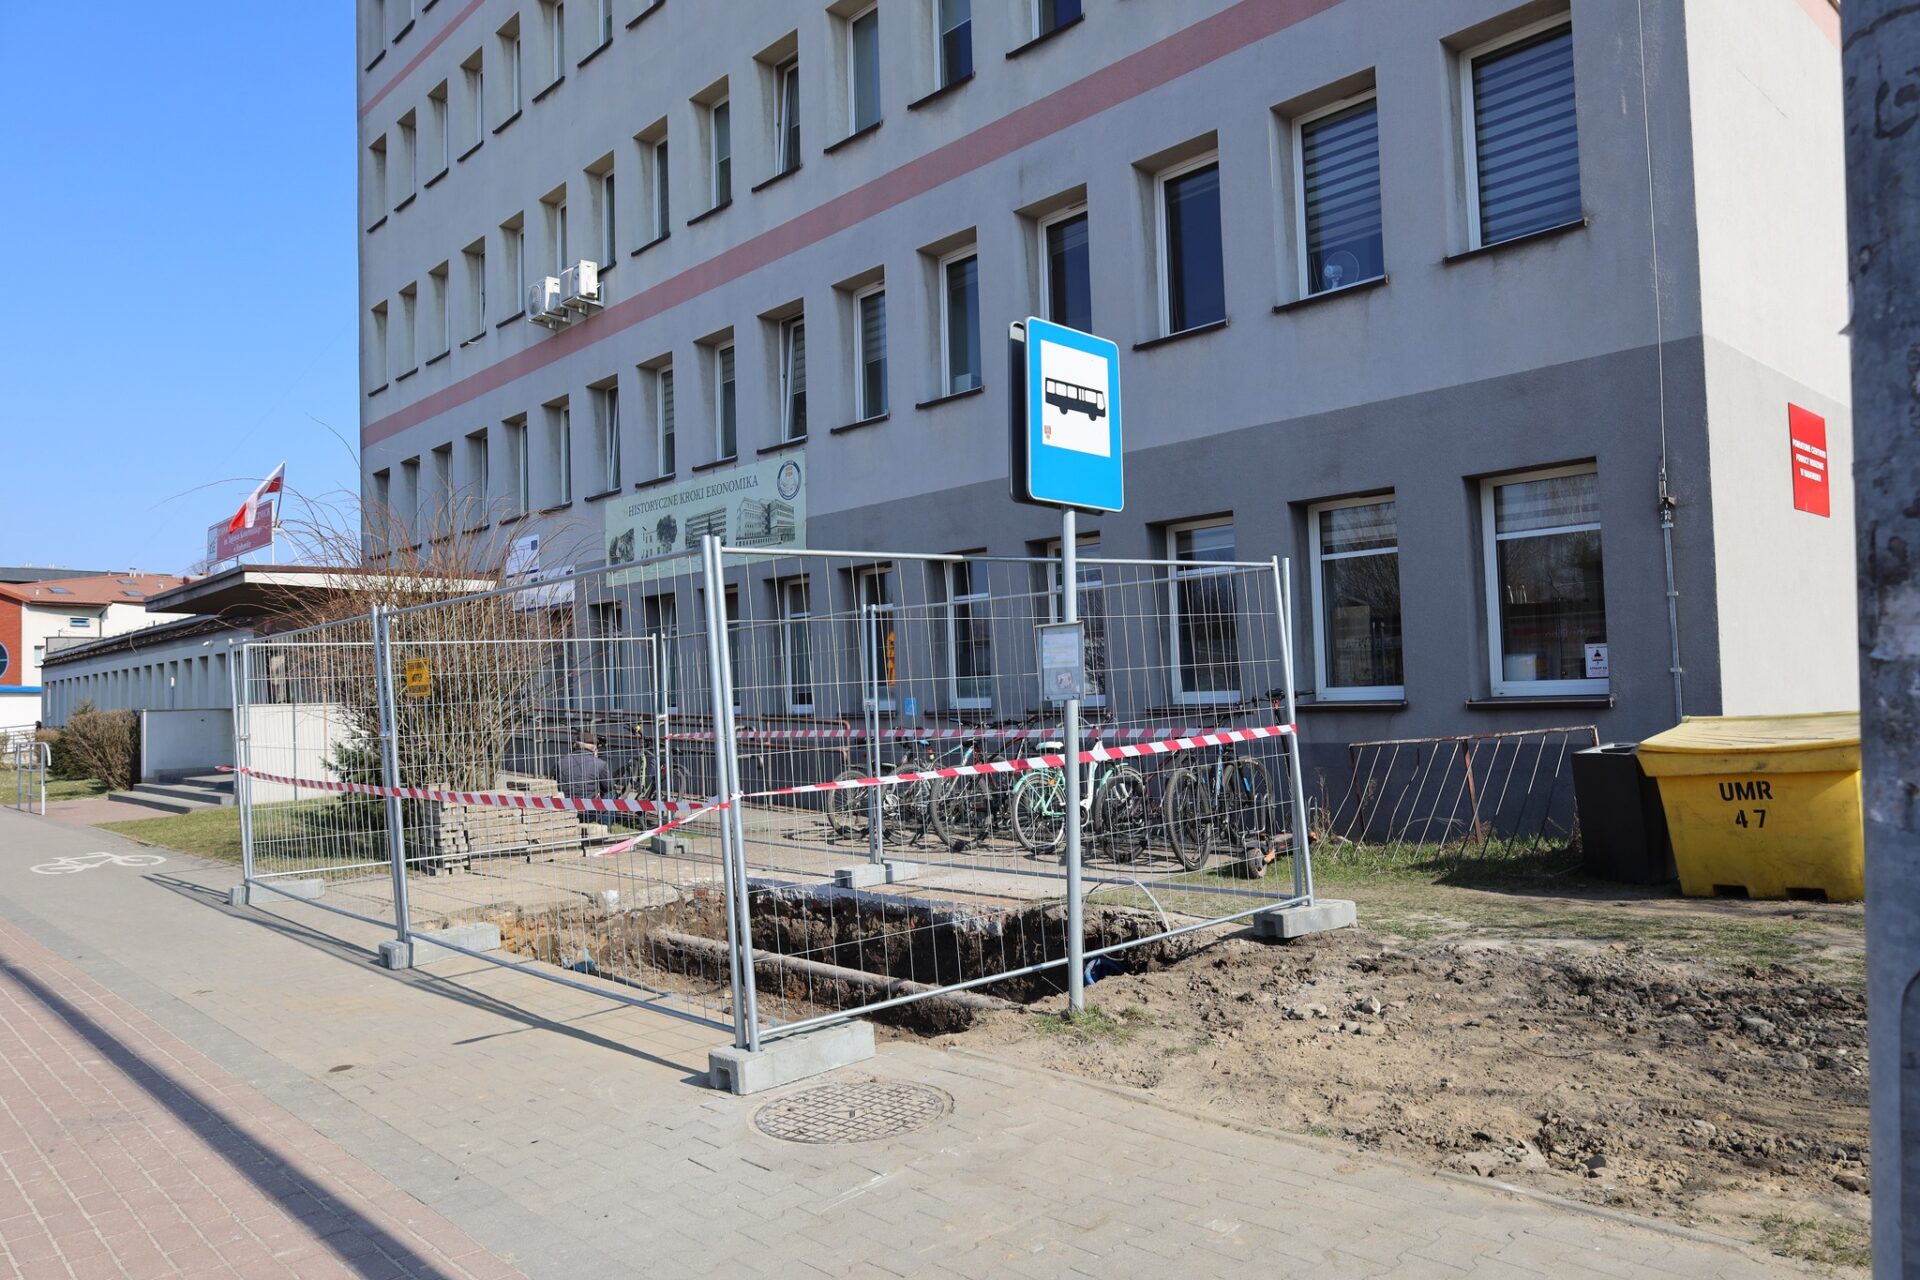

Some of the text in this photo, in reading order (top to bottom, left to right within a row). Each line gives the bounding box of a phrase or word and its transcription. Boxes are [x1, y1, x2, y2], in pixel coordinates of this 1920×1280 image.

[628, 494, 679, 517] HISTORYCZNE
[680, 490, 704, 504] KROKI
[706, 475, 759, 498] EKONOMIKA
[1718, 780, 1774, 801] UMR
